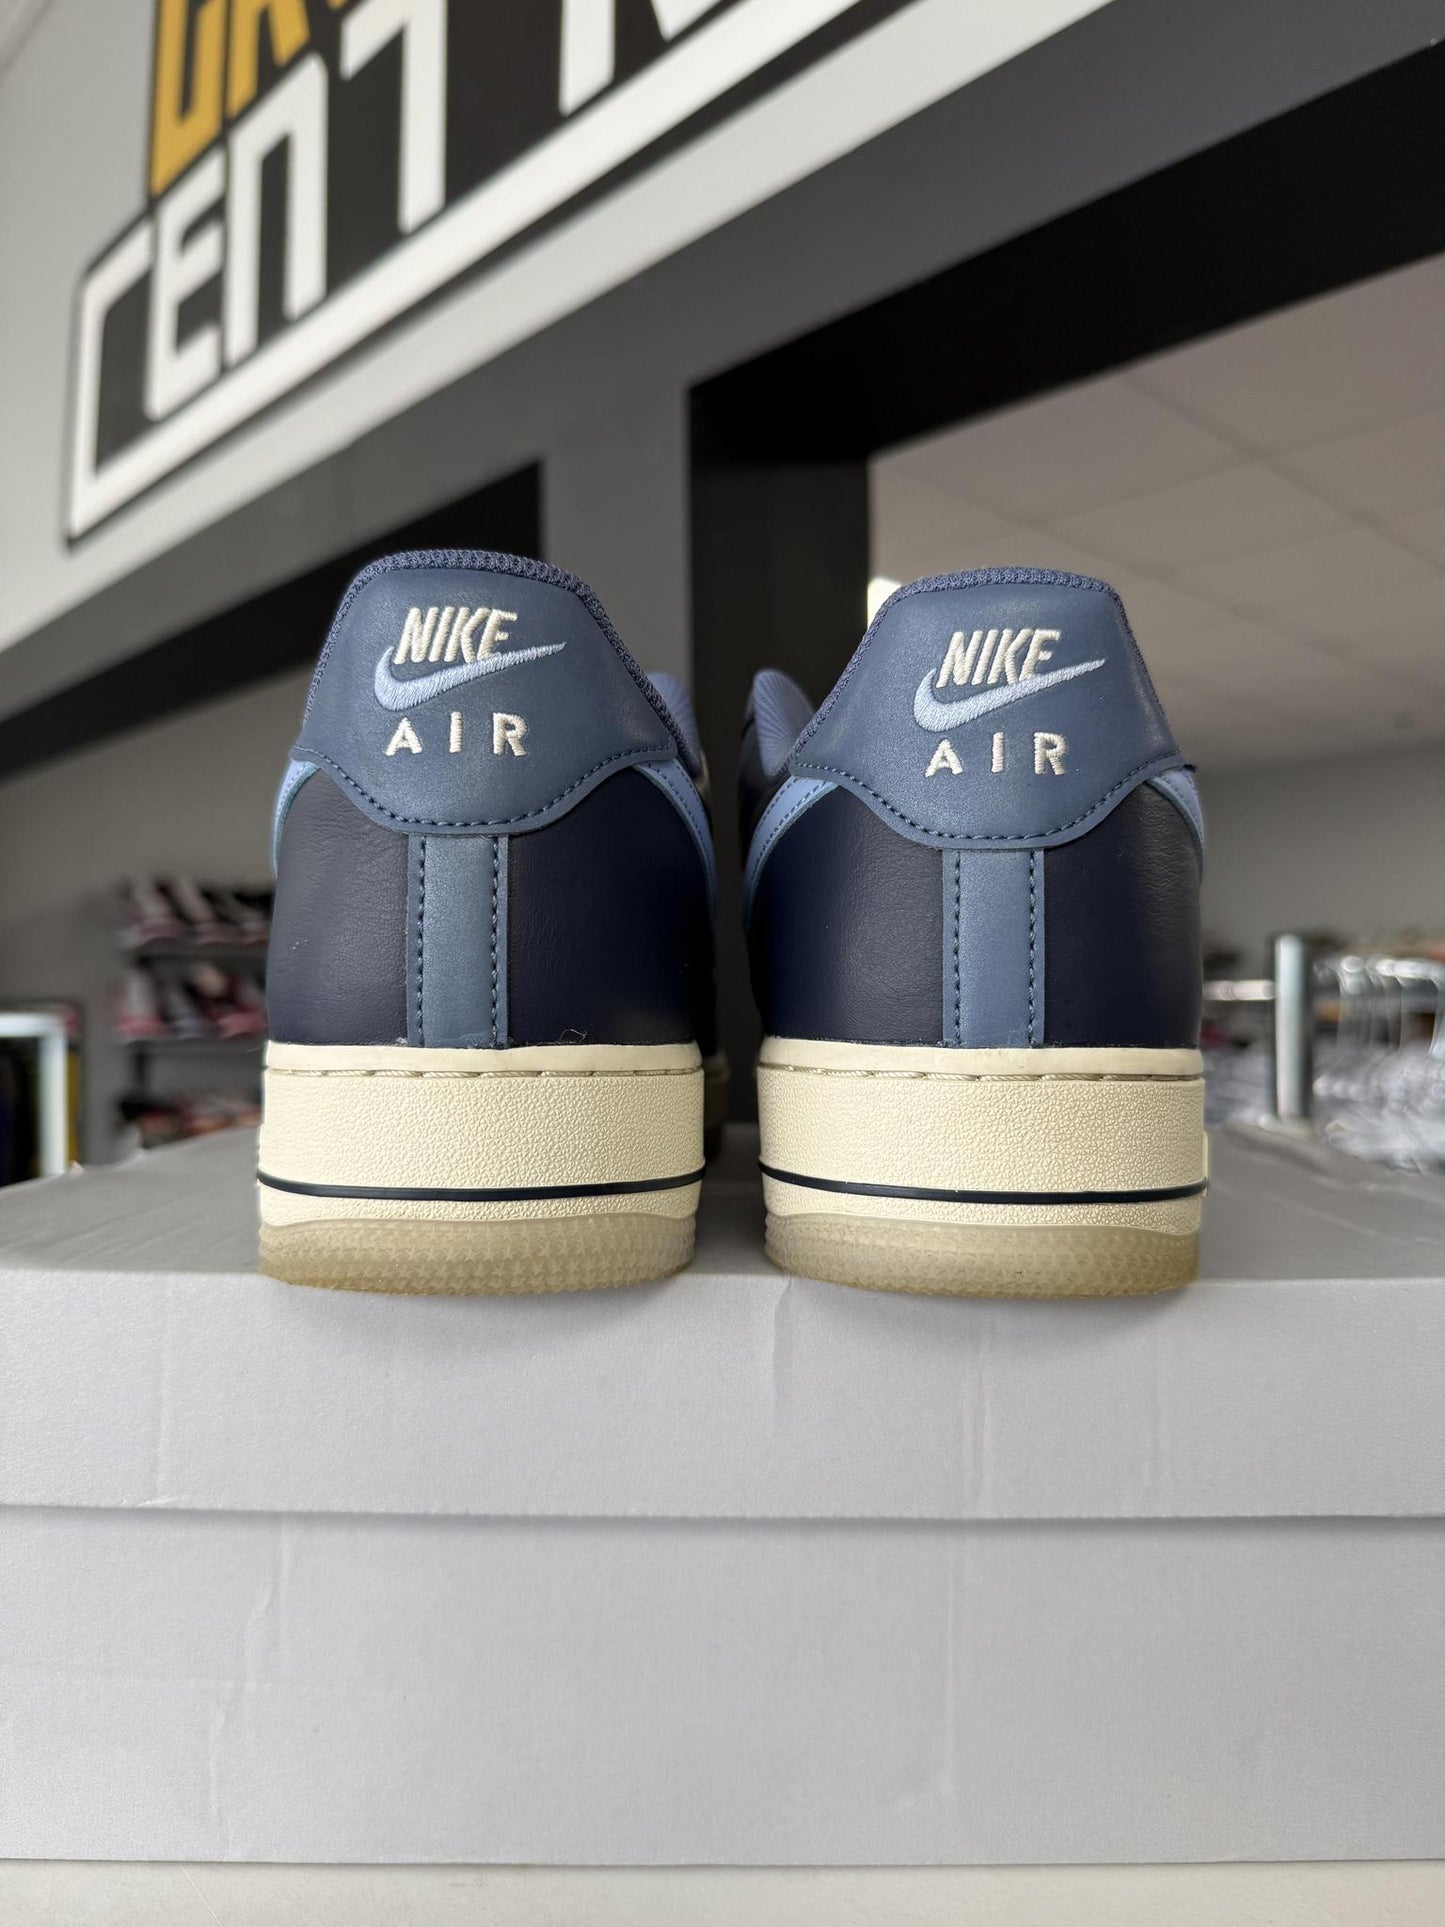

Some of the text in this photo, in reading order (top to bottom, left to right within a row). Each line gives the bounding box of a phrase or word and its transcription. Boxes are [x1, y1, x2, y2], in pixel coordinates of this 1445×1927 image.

[393, 606, 519, 665] NIKE
[935, 628, 1062, 689] NIKE
[384, 711, 528, 757] AIR
[925, 731, 1067, 778] AIR
